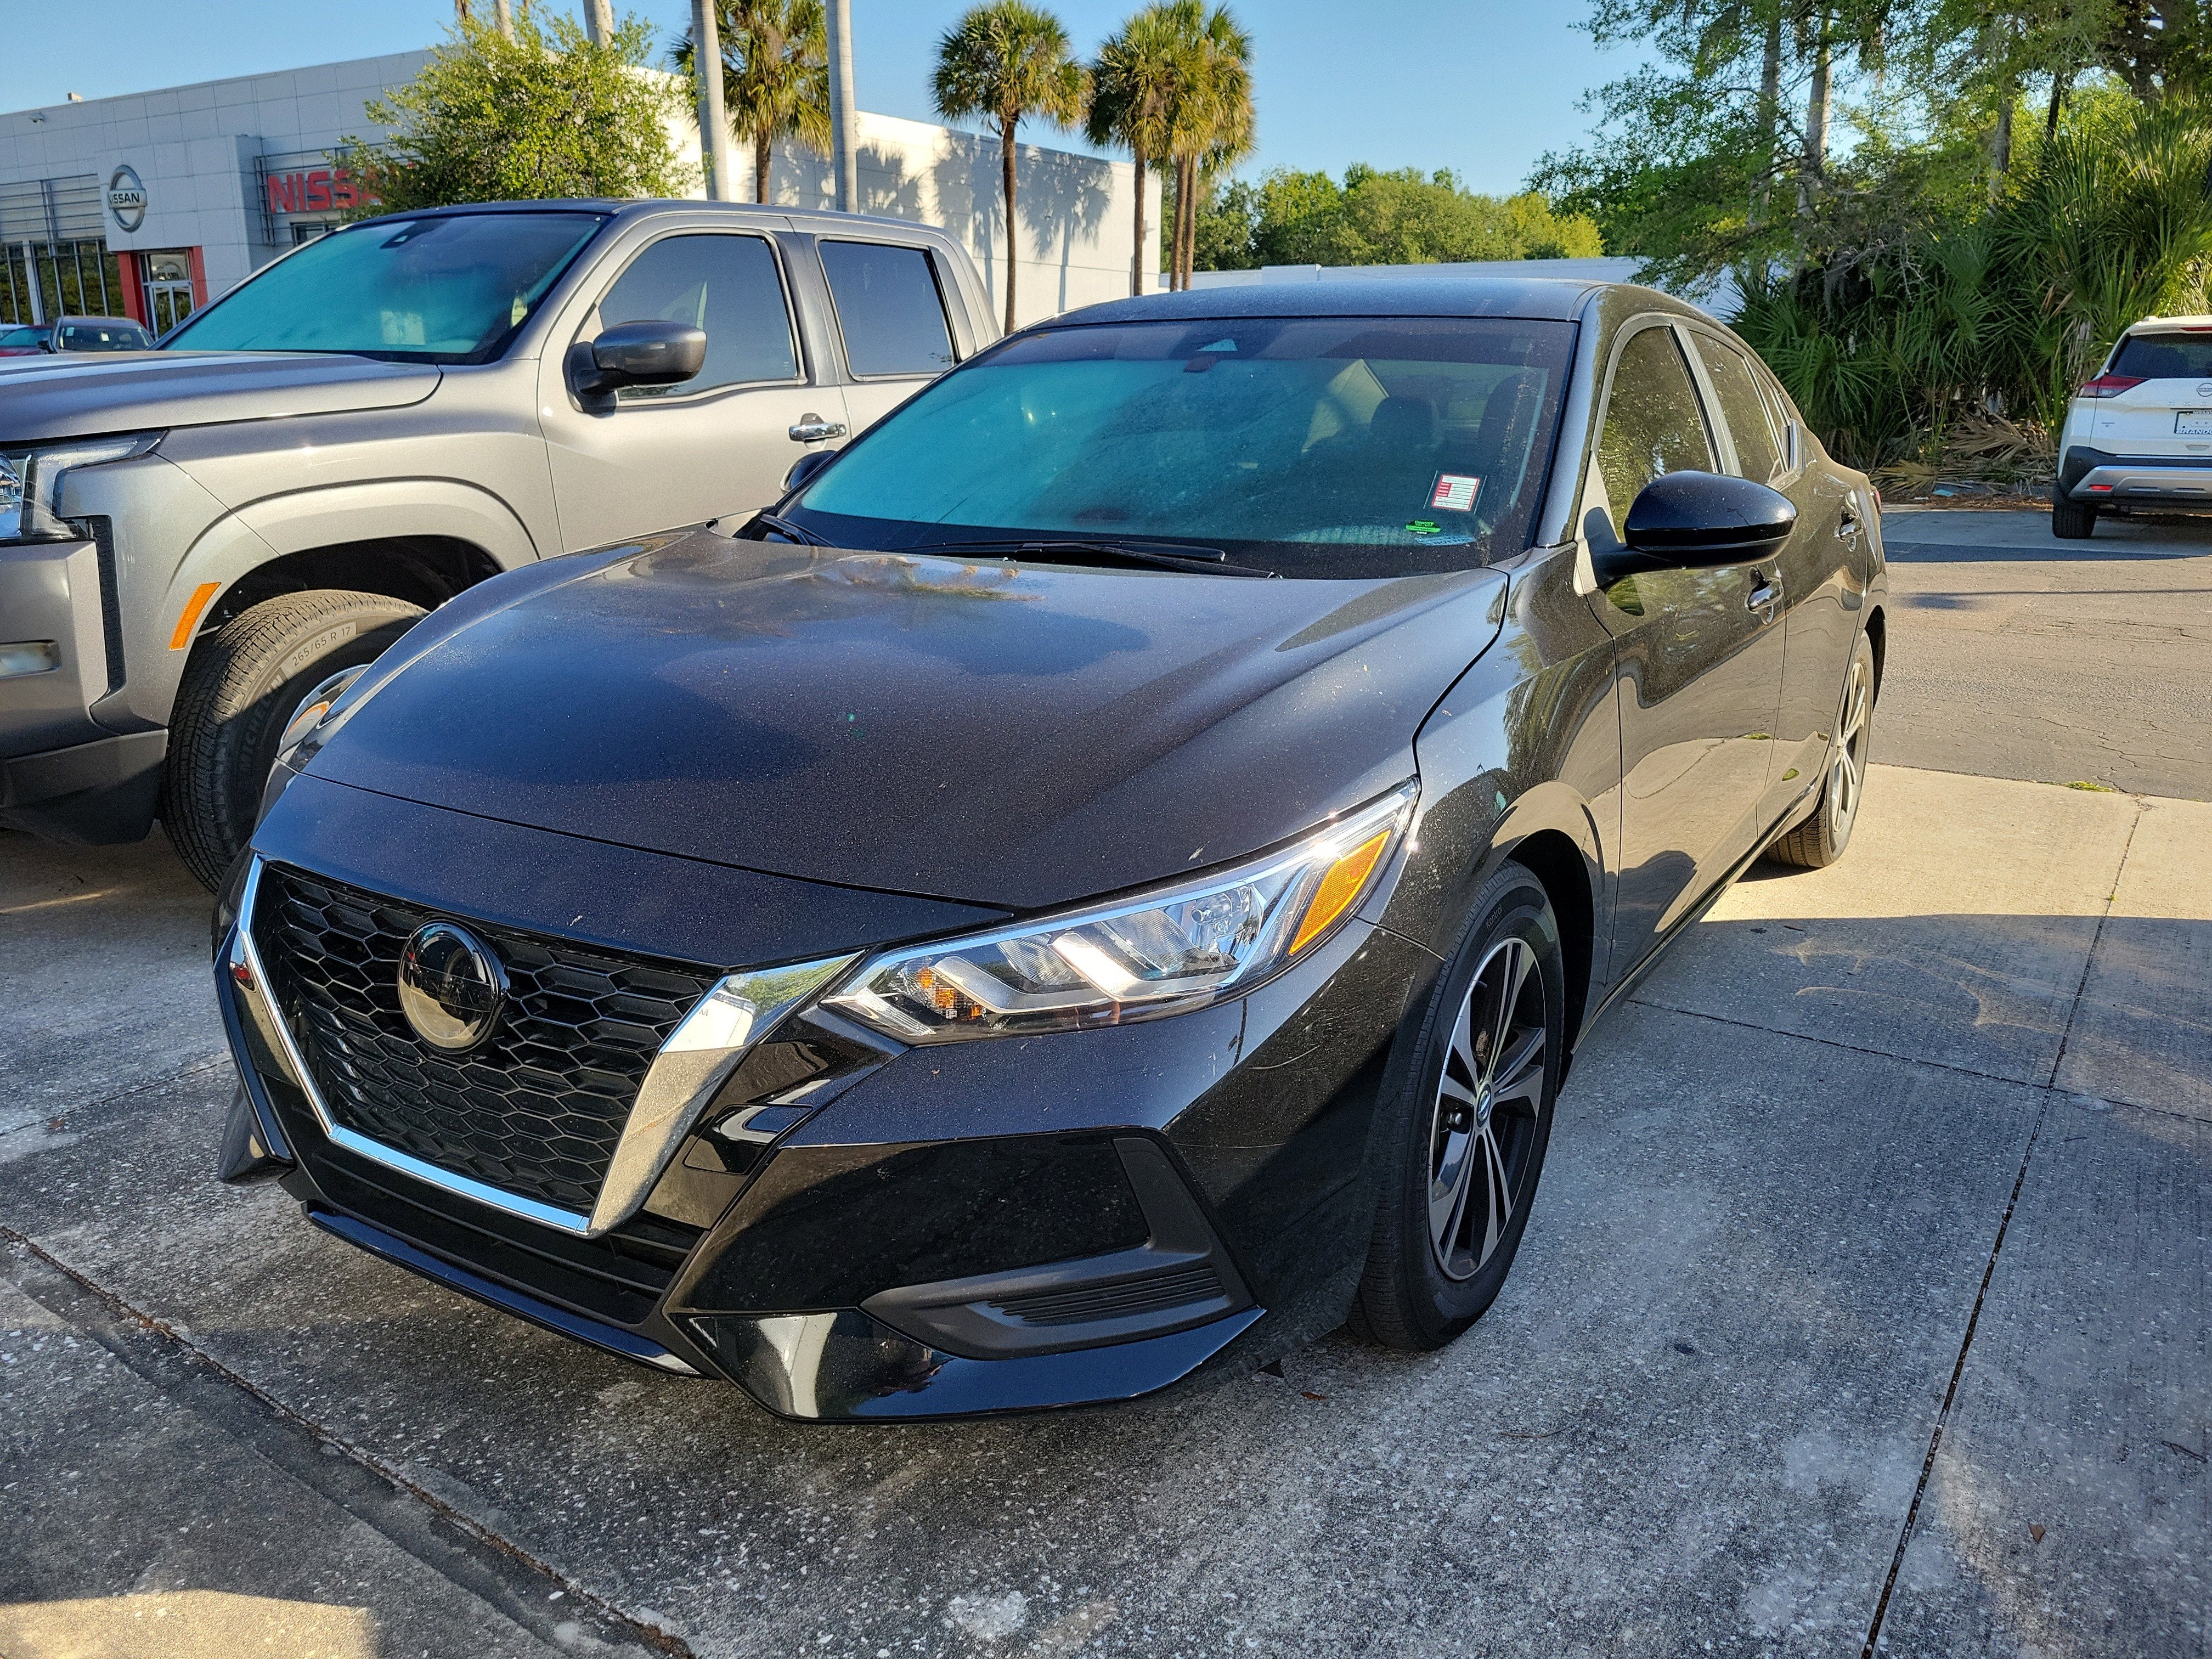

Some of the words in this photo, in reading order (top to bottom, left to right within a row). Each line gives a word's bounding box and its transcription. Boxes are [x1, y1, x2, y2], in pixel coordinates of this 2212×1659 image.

[268, 169, 385, 214] NISS
[292, 636, 327, 667] 265/65
[330, 631, 337, 642] R
[341, 627, 351, 636] 17
[1485, 903, 1503, 930] Kontrol
